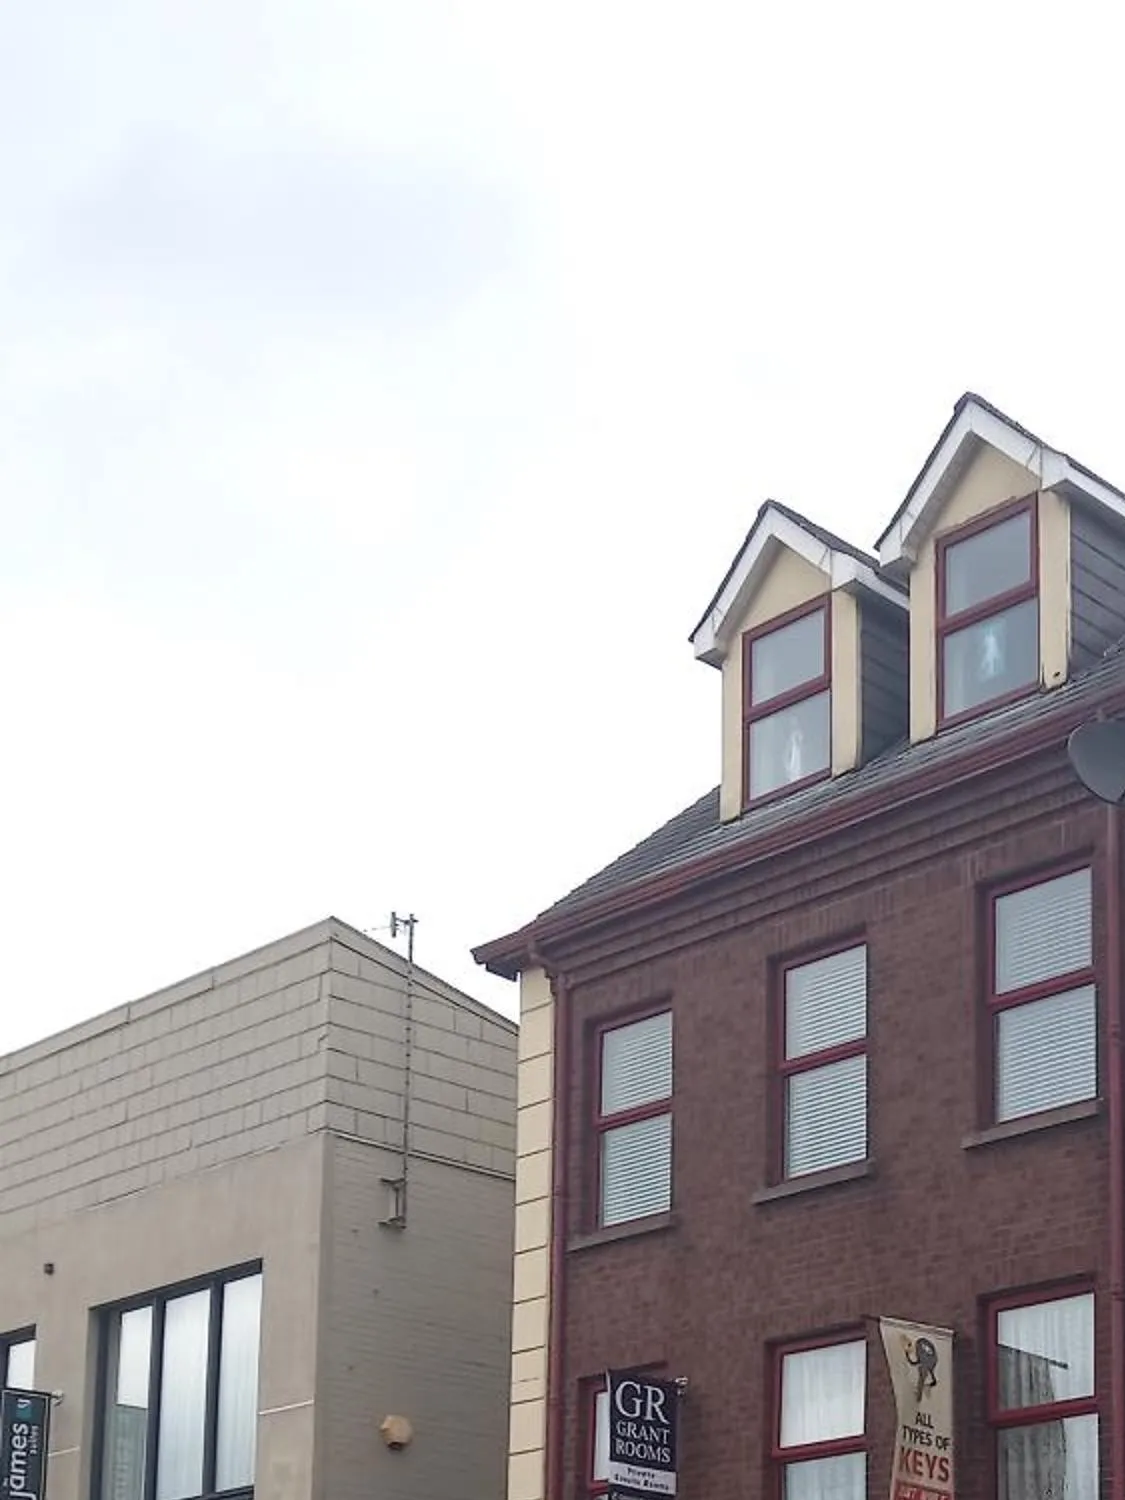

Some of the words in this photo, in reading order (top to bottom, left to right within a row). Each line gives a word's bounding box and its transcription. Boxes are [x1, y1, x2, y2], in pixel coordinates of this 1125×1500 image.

[614, 1381, 671, 1425] GR
[616, 1420, 670, 1445] GRANT
[915, 1412, 934, 1428] ALL
[615, 1438, 671, 1463] ROOMS
[902, 1425, 933, 1446] TYPES
[935, 1435, 951, 1451] OF
[898, 1445, 949, 1482] KEYS
